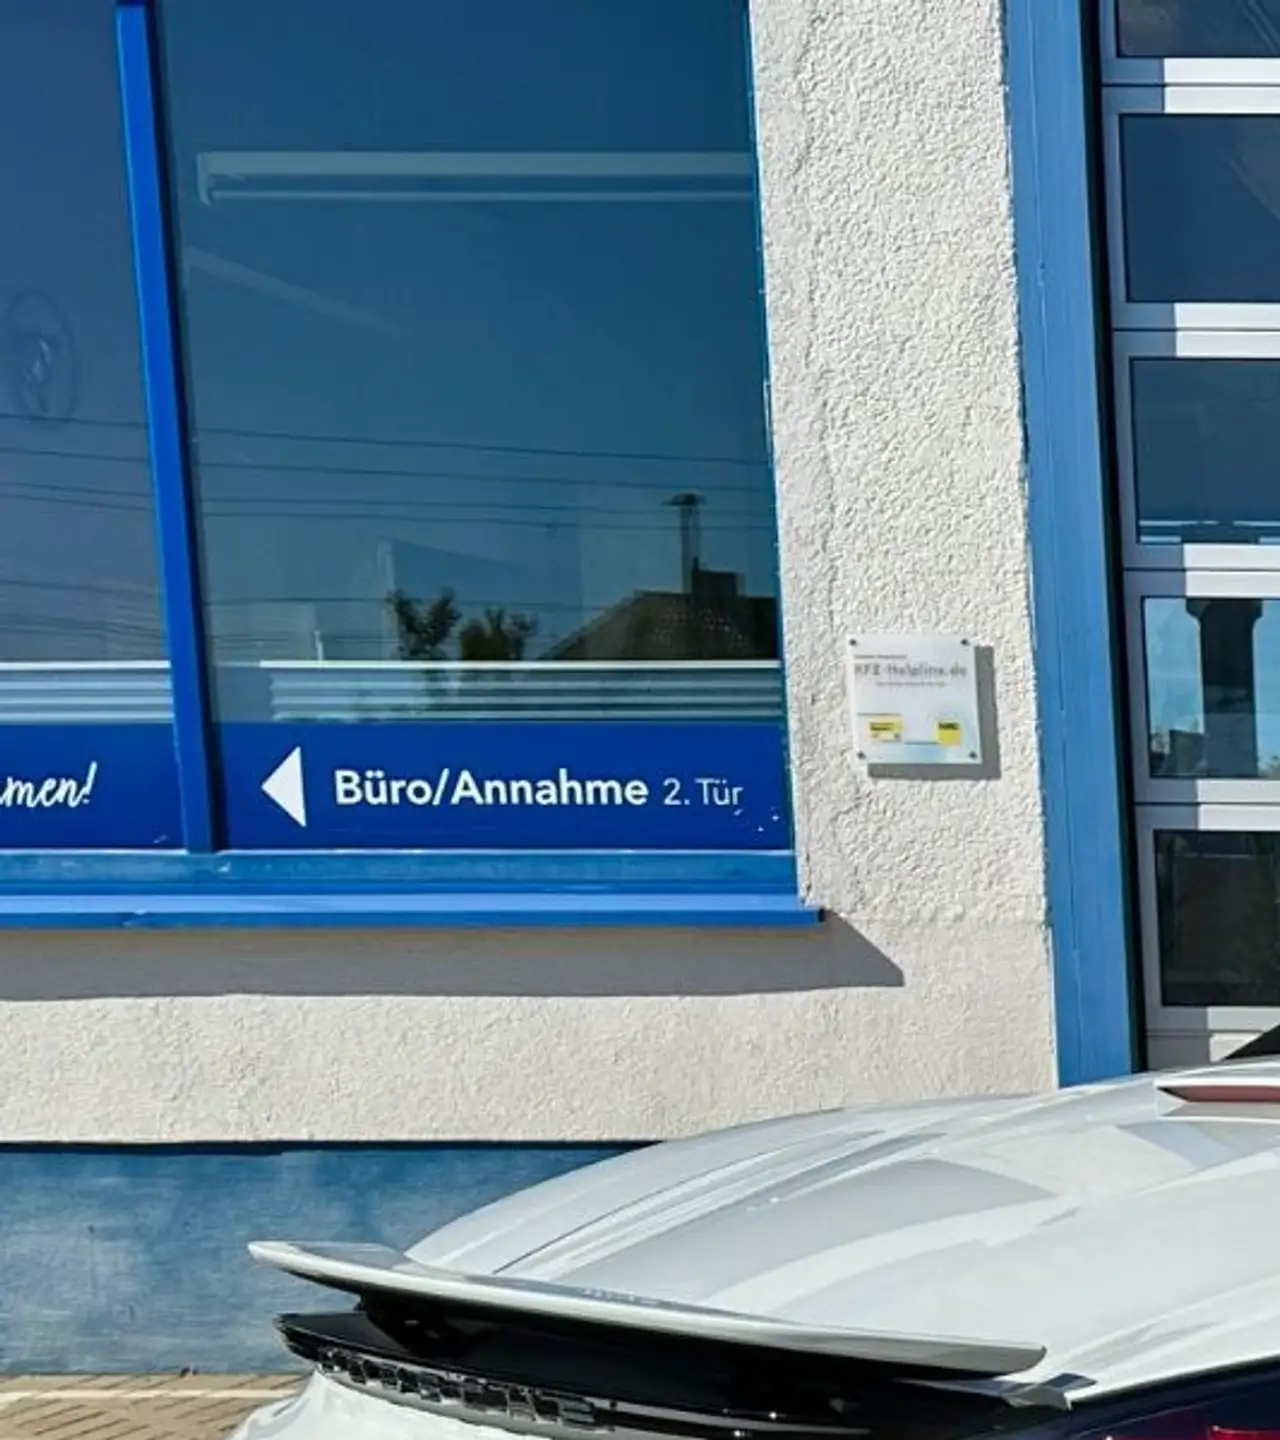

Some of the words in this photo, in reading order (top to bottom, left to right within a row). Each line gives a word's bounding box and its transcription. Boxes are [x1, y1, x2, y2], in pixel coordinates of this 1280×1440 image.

[0, 760, 98, 808] men!
[335, 768, 647, 808] Büro/Annahme
[663, 778, 691, 806] 2.
[695, 777, 743, 807] Tür
